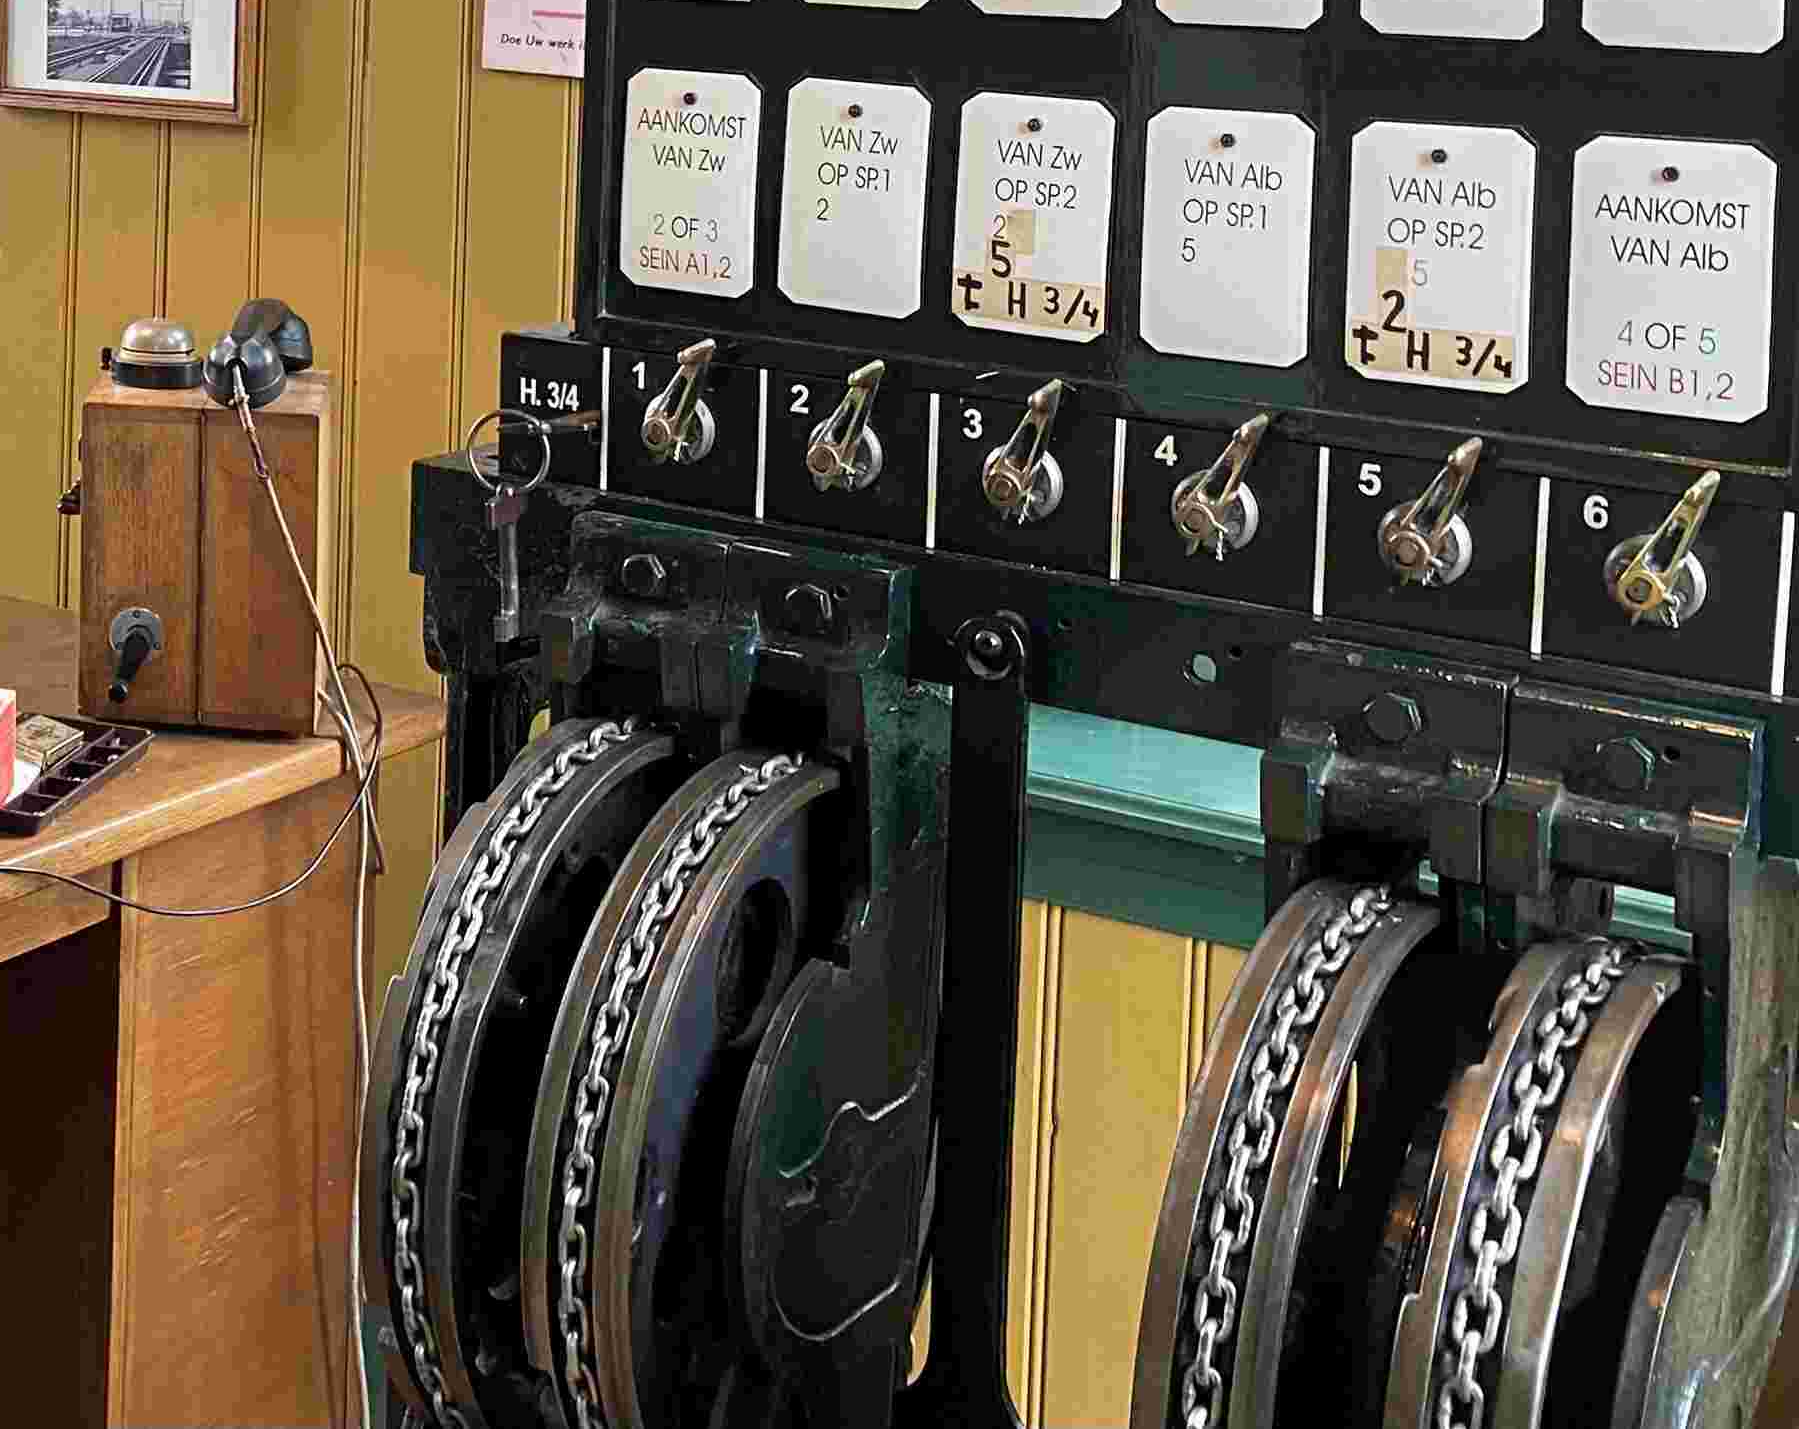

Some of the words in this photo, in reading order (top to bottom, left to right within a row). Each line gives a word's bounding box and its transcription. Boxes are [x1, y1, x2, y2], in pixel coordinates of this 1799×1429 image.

[500, 33, 521, 45] Doe
[638, 108, 746, 138] AANKOMST
[821, 126, 862, 151] VAN
[869, 131, 897, 154] Zw
[998, 140, 1043, 167] VAN
[1051, 146, 1082, 170] Zw
[653, 145, 692, 168] VAN
[699, 149, 725, 171] Zw
[818, 162, 848, 186] OP
[1185, 159, 1233, 186] VAN
[1241, 163, 1282, 190] Alb
[996, 178, 1027, 202] OP
[1035, 182, 1076, 209] SP.2
[1389, 176, 1442, 204] VAN
[1452, 182, 1496, 208] Alb
[817, 198, 828, 221] 2
[1184, 199, 1218, 225] OP
[1595, 194, 1749, 229] AANKOMST
[654, 214, 664, 235] 2
[672, 216, 699, 238] OF
[705, 219, 717, 242] 3
[994, 215, 1005, 239] 2
[1388, 218, 1426, 244] OP
[1435, 221, 1483, 250] SP.2
[640, 246, 679, 272] SEIN
[992, 240, 1011, 278] 5
[1182, 238, 1195, 262] 5
[1611, 236, 1669, 266] VAN
[1680, 242, 1728, 271] Alb
[1412, 259, 1427, 286] 5
[1008, 281, 1026, 319] H
[1044, 286, 1098, 327] 3/4
[1382, 290, 1407, 333] 2
[1618, 321, 1632, 346] 4
[1645, 323, 1685, 350] OF
[1699, 328, 1715, 354] 5
[1407, 330, 1429, 371] H
[1456, 336, 1512, 378] 3/4
[632, 362, 645, 389] 1
[1598, 360, 1656, 391] SEIN
[521, 378, 541, 406] H.
[547, 382, 579, 411] 3/4
[790, 385, 808, 413] 2
[963, 409, 982, 438] 3
[1155, 435, 1177, 466] 4
[1359, 463, 1381, 495] 5
[1584, 495, 1608, 529] 6
